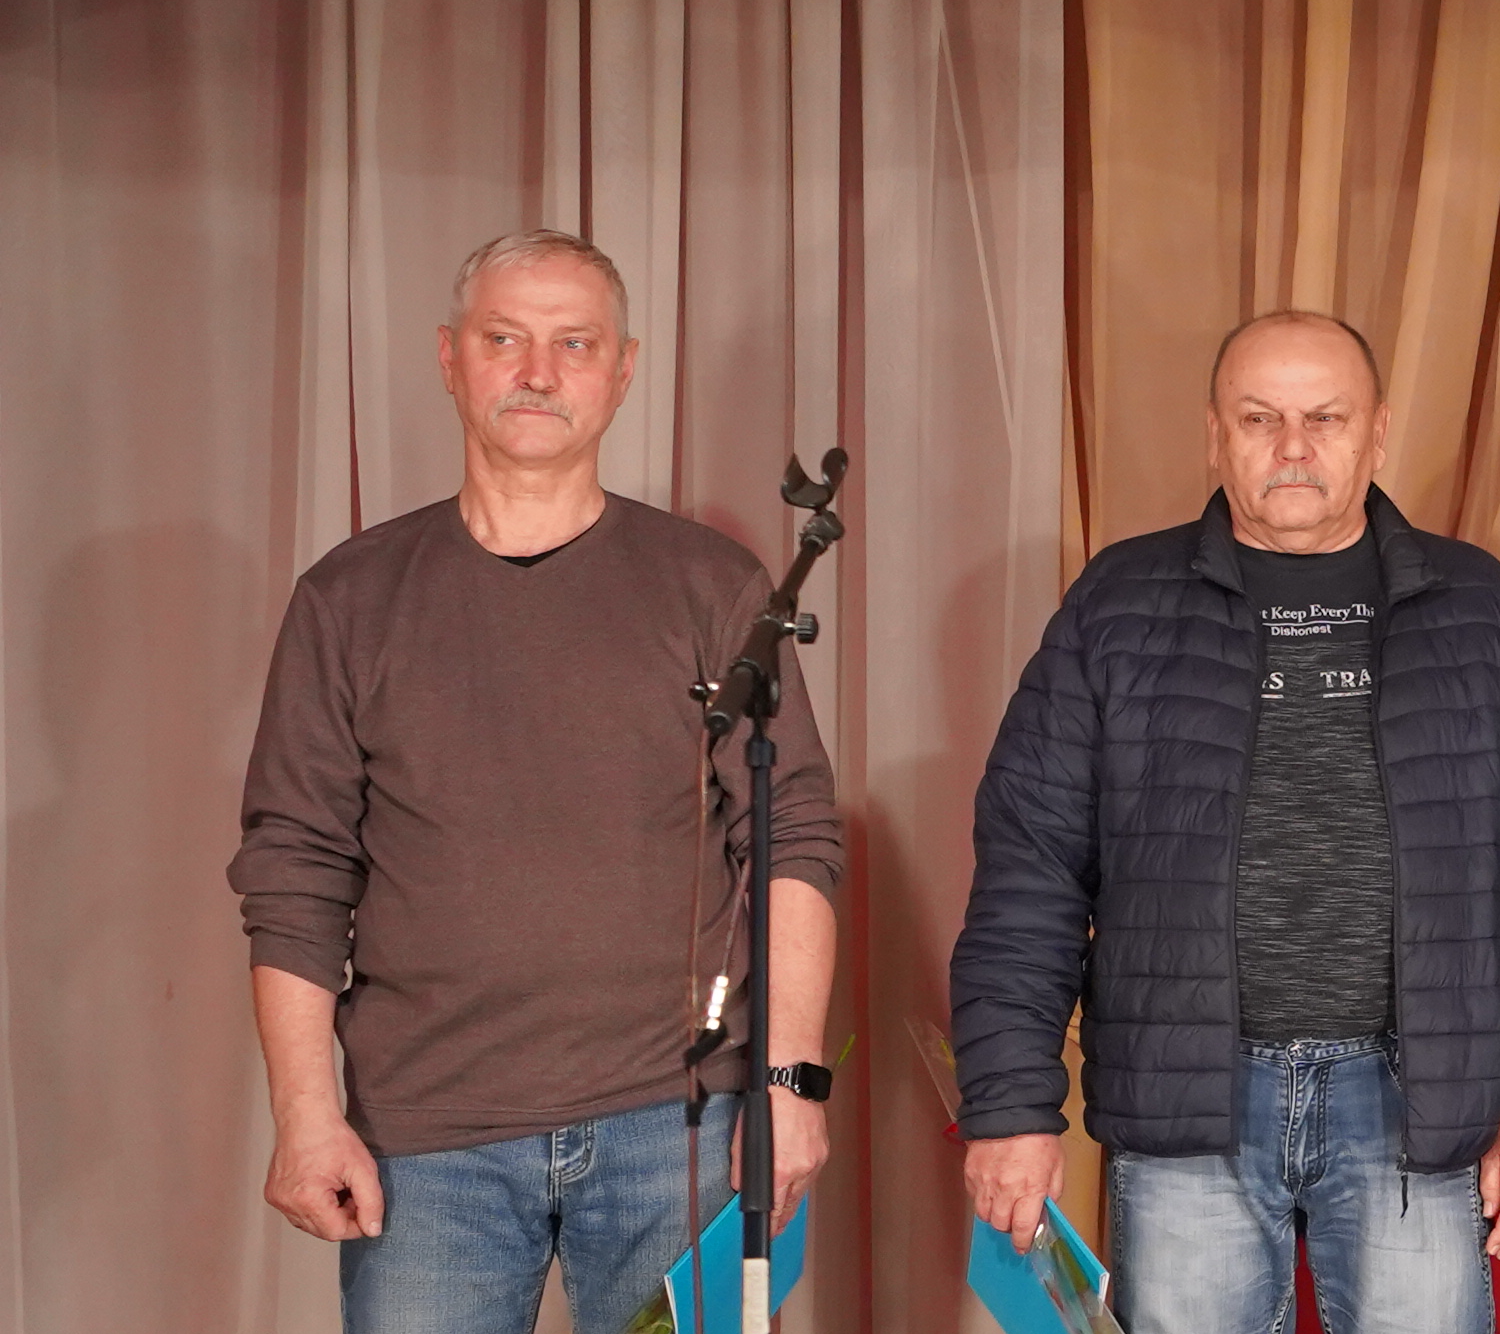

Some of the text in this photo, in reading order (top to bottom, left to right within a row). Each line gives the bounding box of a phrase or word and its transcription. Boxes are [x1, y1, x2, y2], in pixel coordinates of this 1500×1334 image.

[1271, 606, 1306, 623] Keep
[1309, 604, 1350, 621] Every
[1271, 625, 1332, 636] Dishonest
